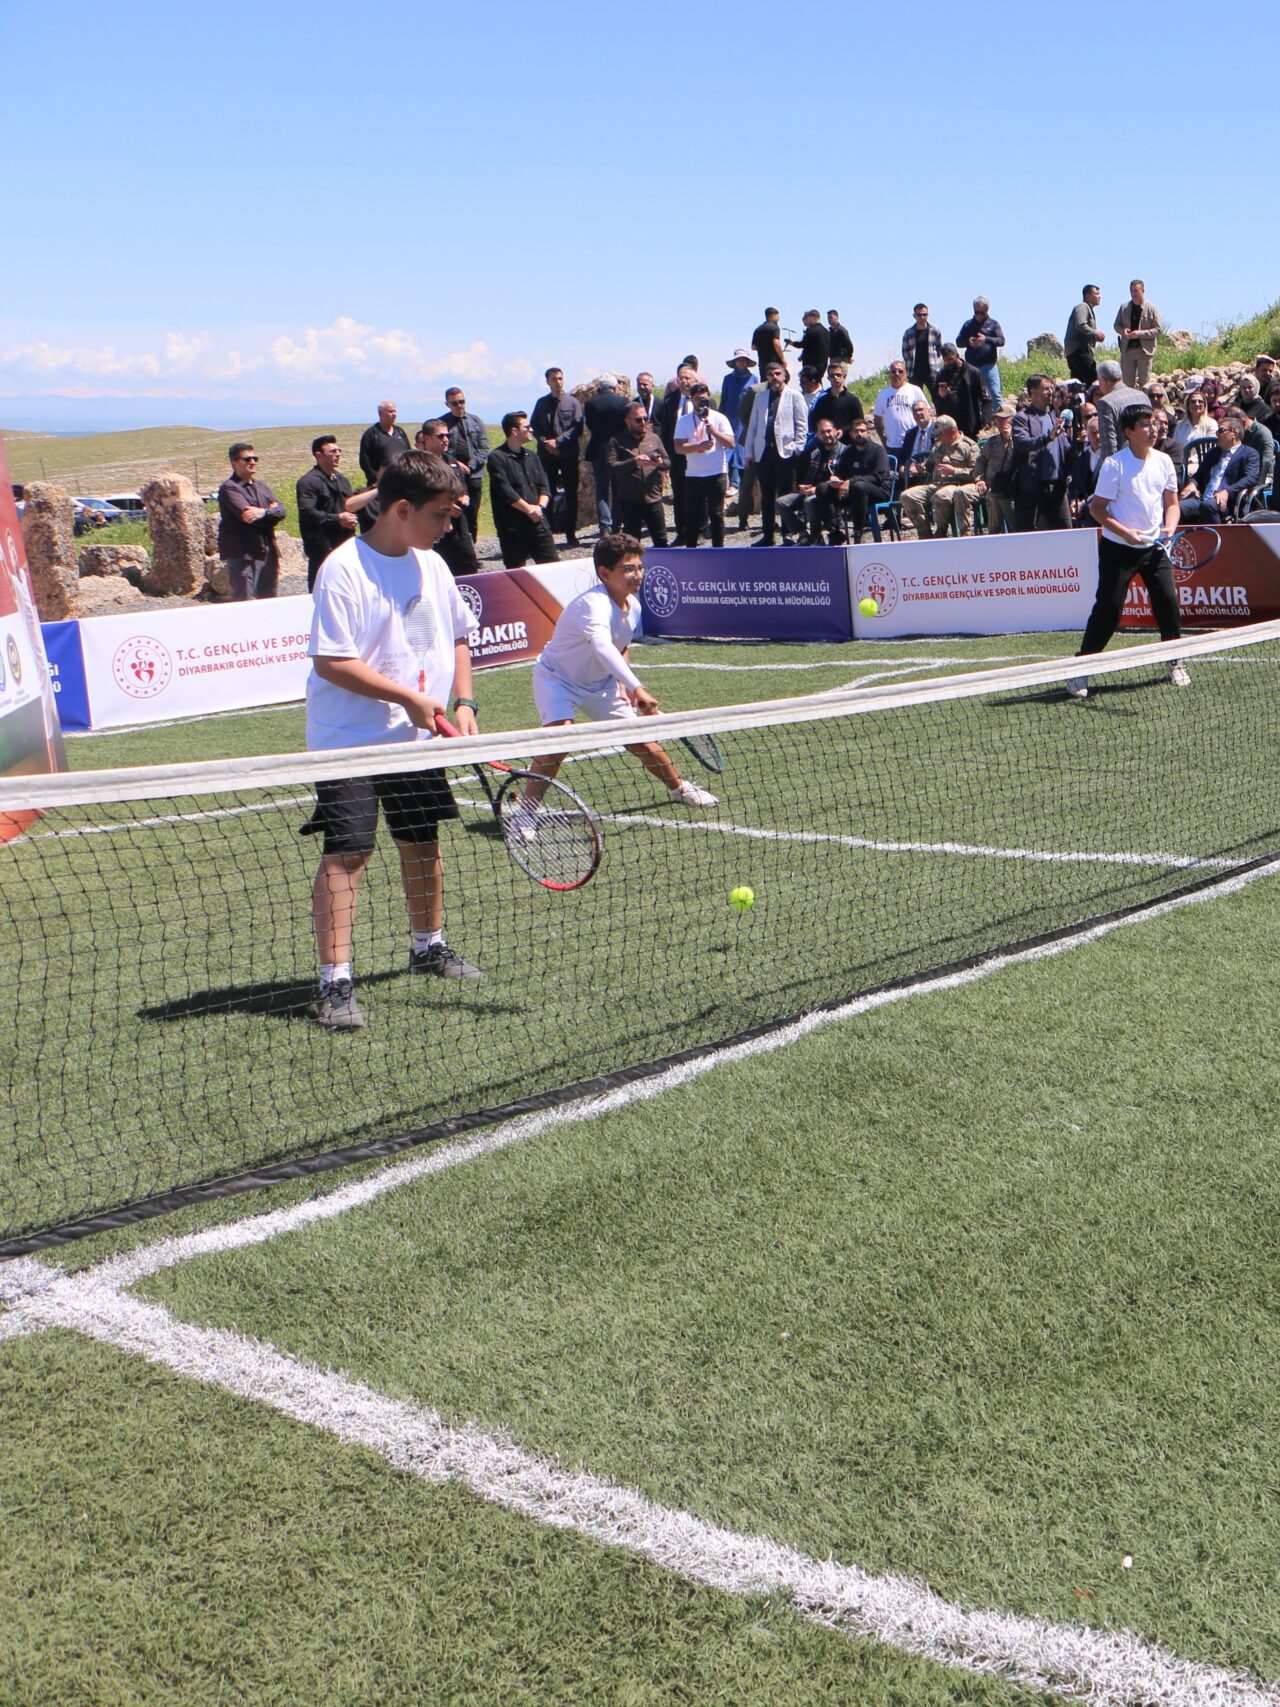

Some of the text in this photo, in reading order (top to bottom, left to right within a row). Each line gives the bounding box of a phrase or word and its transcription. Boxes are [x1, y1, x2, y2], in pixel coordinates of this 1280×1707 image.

[901, 565, 1079, 588] T.C. GENÇLİK VE SPOR BAKANLIĞI
[680, 579, 830, 594] T.C. GENÇLİK VE SPOR BAKANLIĞI
[902, 582, 1081, 602] DİYARBAKIR GENÇLİK VE SPOR İL MÜDÜRLÜĞÜ
[720, 595, 748, 607] GENÇLİK
[748, 596, 758, 605] VE
[758, 596, 777, 606] SPOR
[784, 595, 832, 606] MÜDÜRLÜĞÜ
[1186, 606, 1195, 616] İL
[1195, 606, 1251, 616] MÜDÜRLÜĞÜ
[176, 648, 200, 661] T.C.
[203, 639, 259, 657] GENÇLİK
[262, 638, 278, 650] VE
[481, 639, 529, 656] MÜDÜRLÜĞÜ
[178, 660, 235, 677] DİYARBAKIR
[236, 655, 274, 670] GENÇLİK
[275, 652, 288, 664] VE
